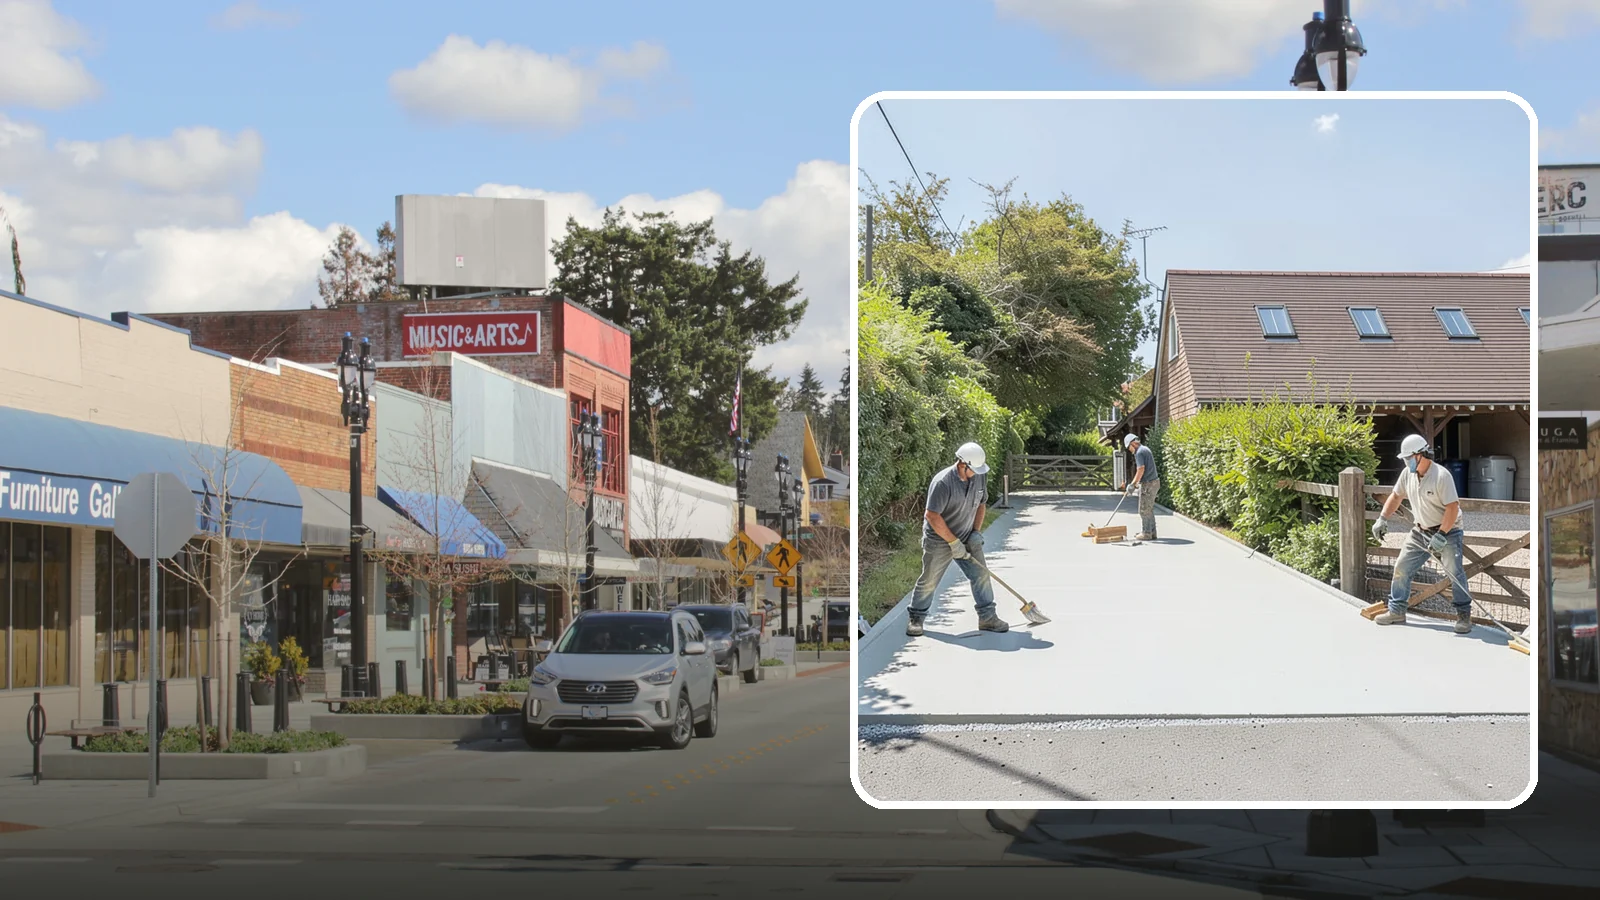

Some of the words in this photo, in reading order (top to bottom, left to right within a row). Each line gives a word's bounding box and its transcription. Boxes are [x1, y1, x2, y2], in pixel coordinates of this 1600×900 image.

[1540, 427, 1577, 437] UGA
[0, 471, 79, 515] Furniture
[89, 482, 122, 519] Gal
[453, 563, 479, 574] SUSHI
